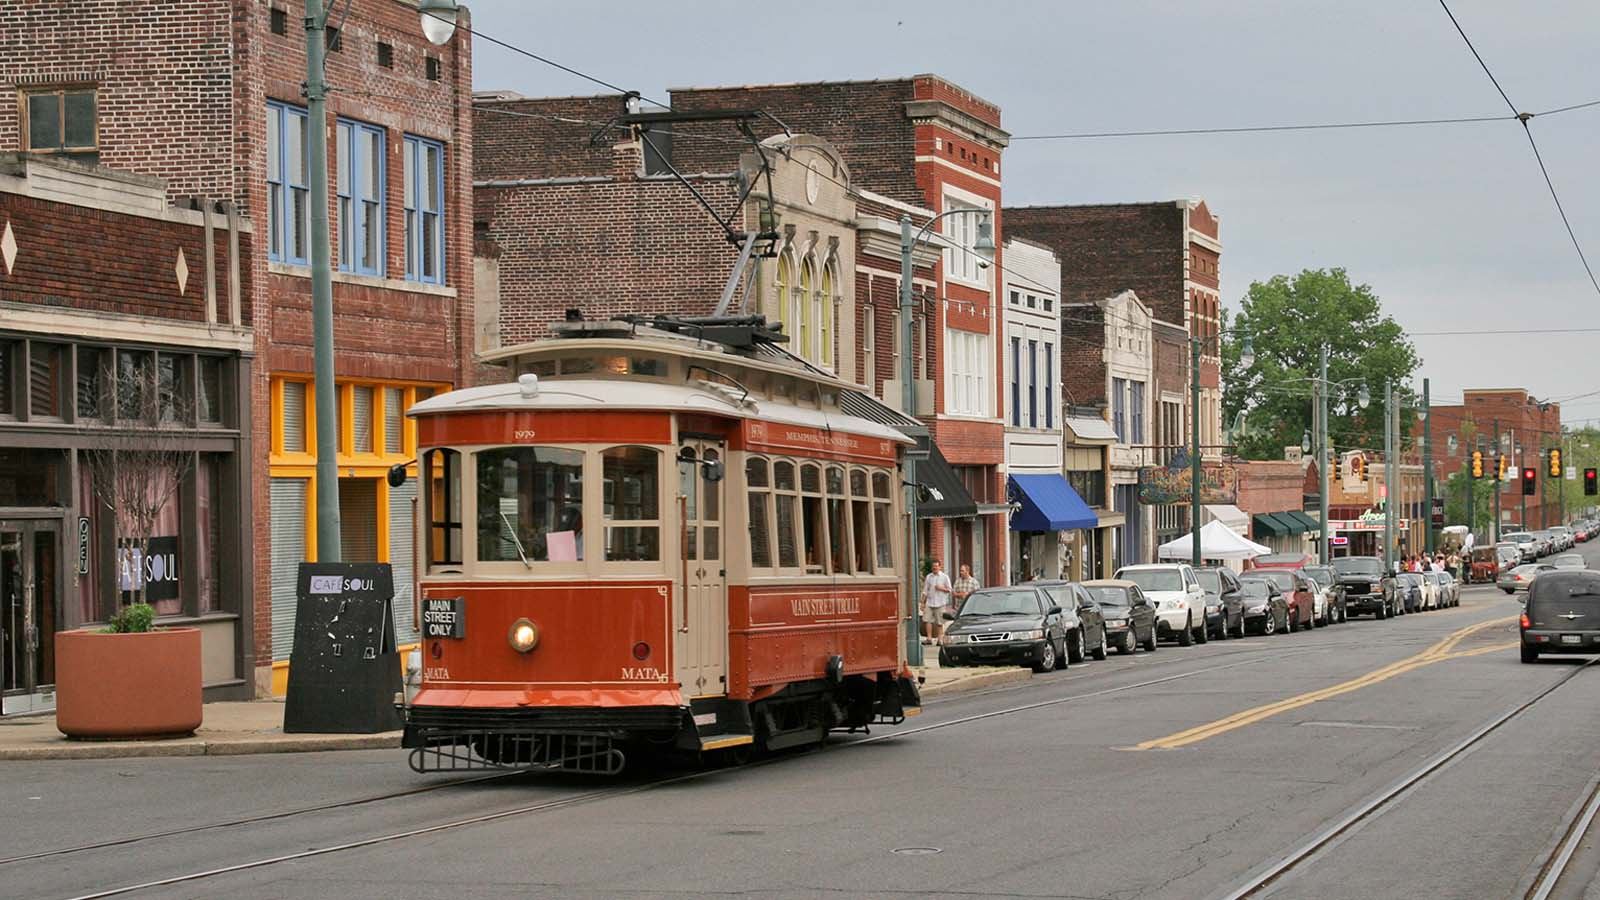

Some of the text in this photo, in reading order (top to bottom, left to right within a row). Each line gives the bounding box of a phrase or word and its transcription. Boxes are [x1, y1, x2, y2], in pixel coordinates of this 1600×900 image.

[514, 431, 535, 439] 1979
[146, 553, 178, 582] SOUL
[313, 578, 374, 591] CAFE SOUL
[429, 600, 451, 611] MAIN
[424, 611, 457, 623] STREET
[429, 624, 452, 635] ONLY
[427, 668, 449, 679] MATA
[622, 667, 660, 680] MATA
